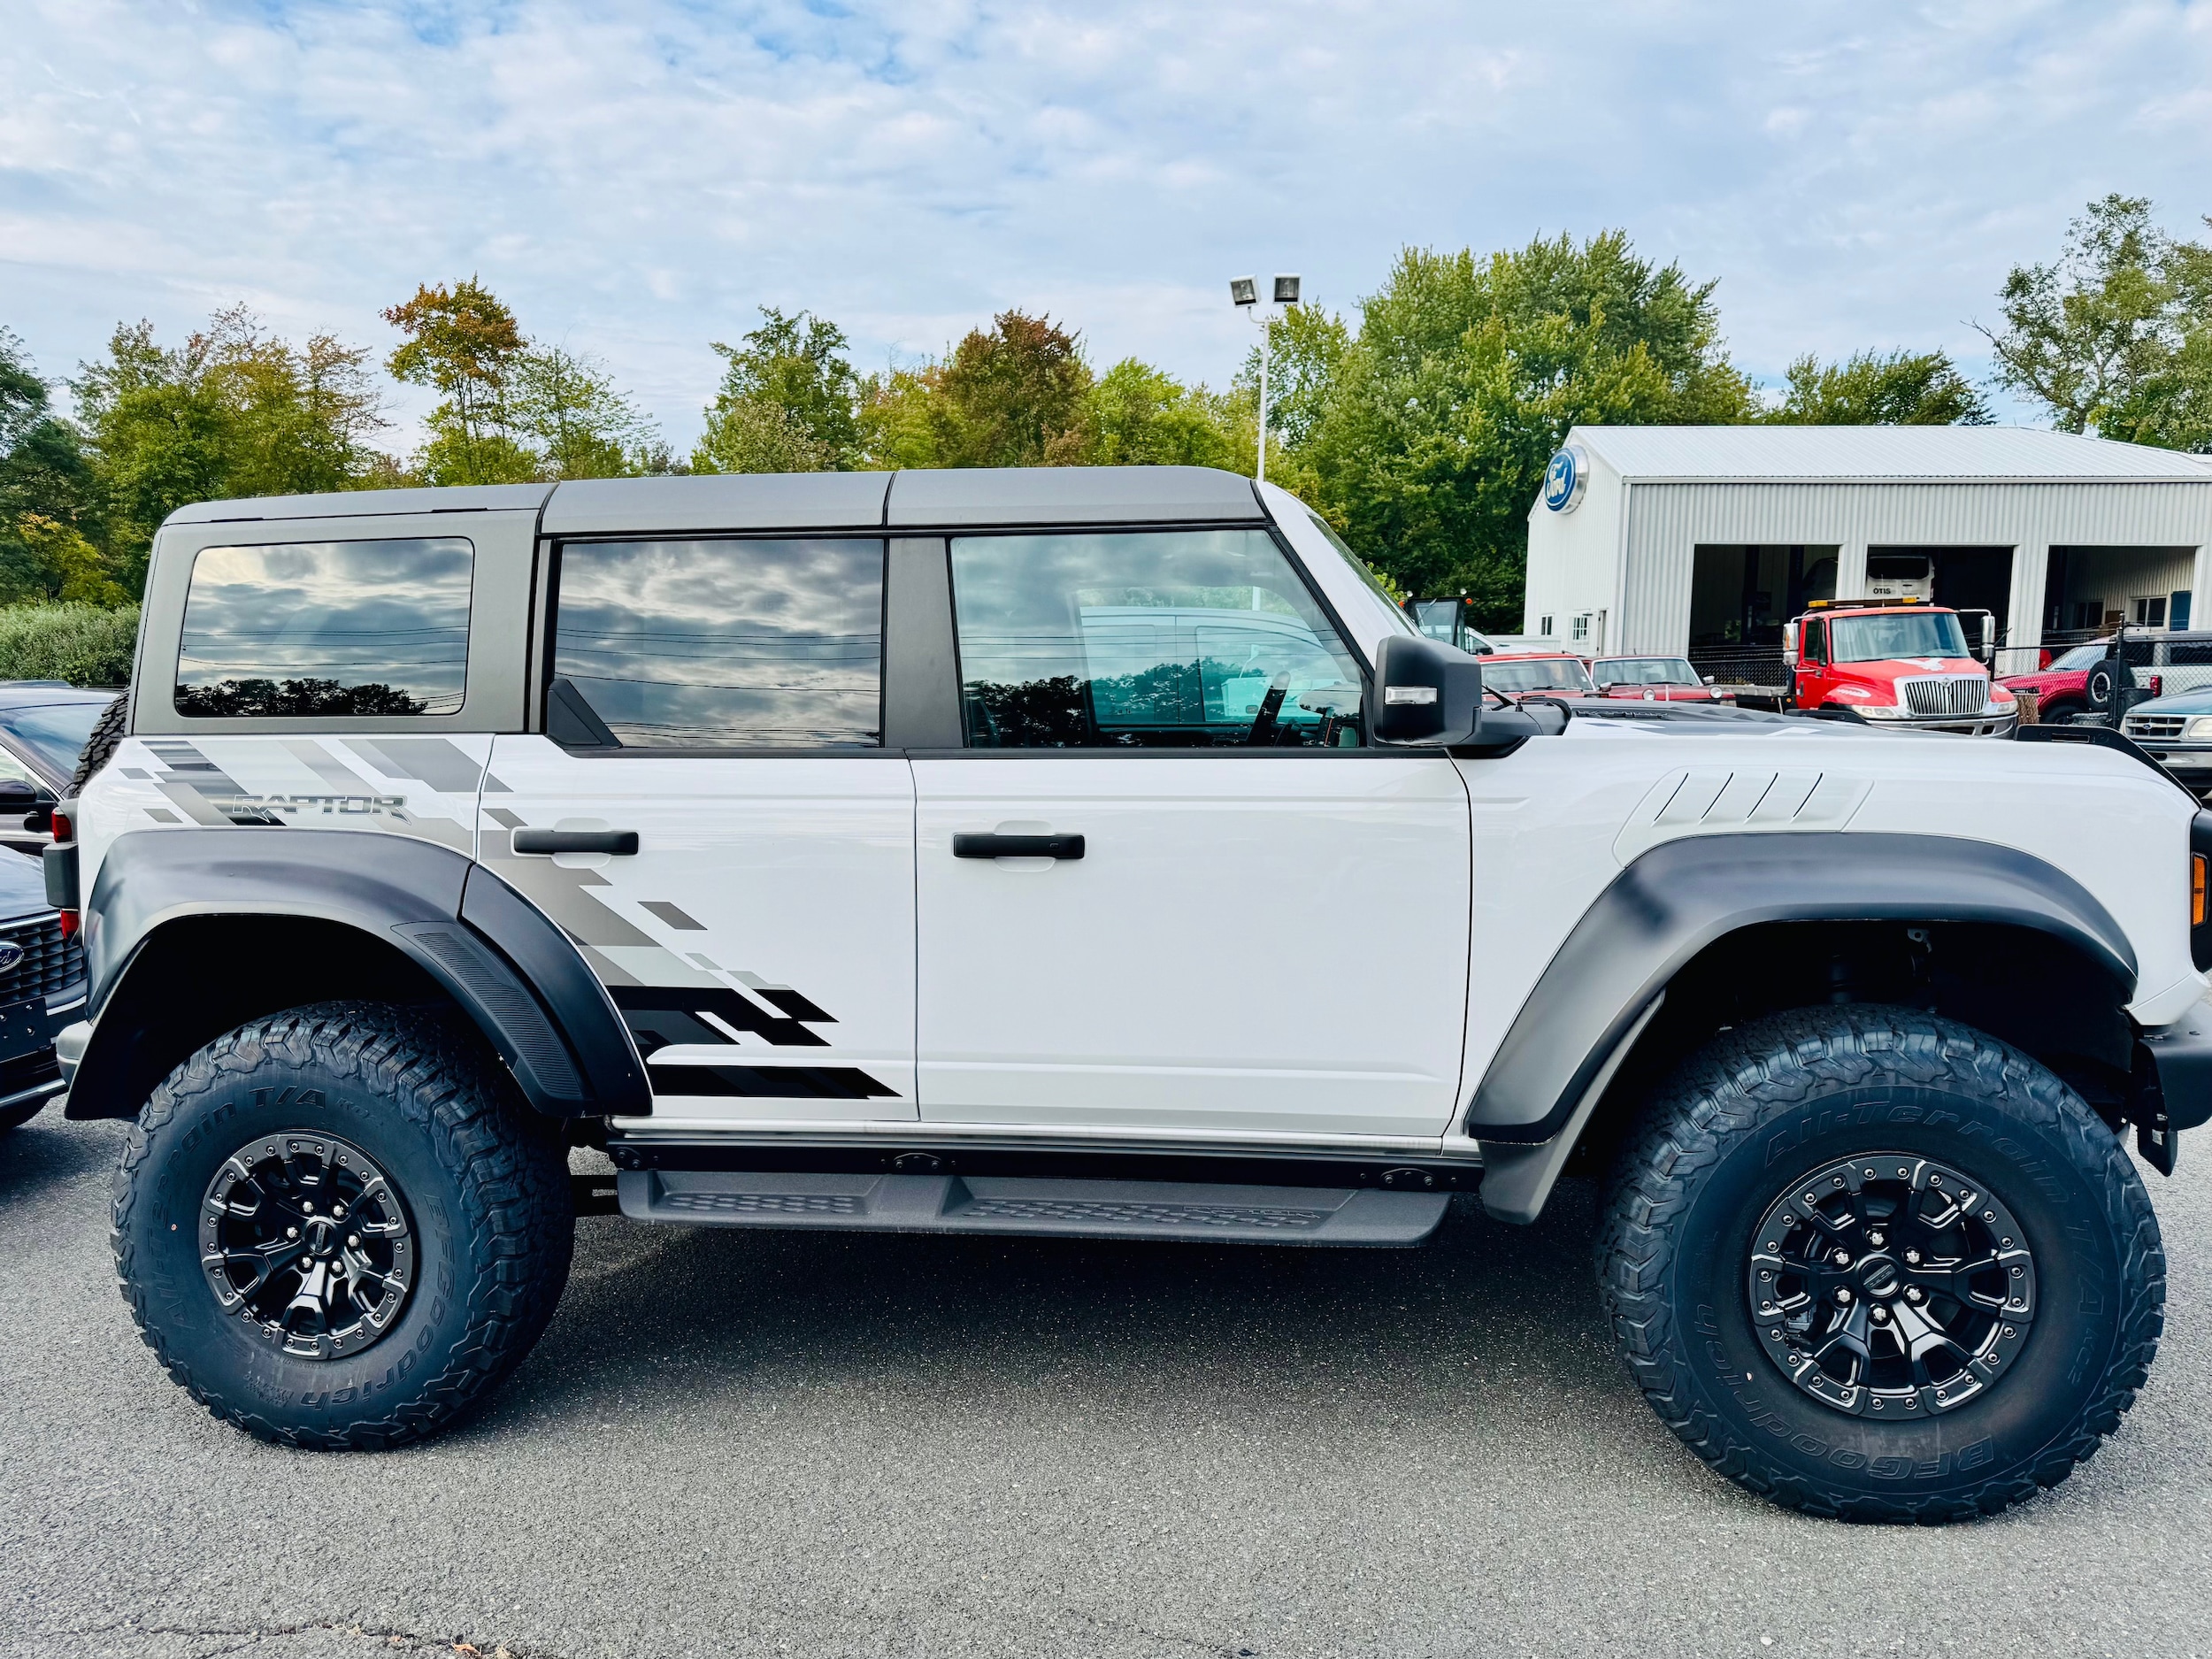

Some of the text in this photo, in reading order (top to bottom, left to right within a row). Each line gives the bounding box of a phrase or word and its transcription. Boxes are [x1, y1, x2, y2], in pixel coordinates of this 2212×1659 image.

[1546, 461, 1568, 499] Ford
[233, 795, 411, 826] RAPTOR
[249, 1085, 326, 1109] T/A
[1764, 1100, 2070, 1204] All-Terrain
[300, 1194, 455, 1411] BFGoodrich
[1693, 1302, 1995, 1480] BFGoodrich
